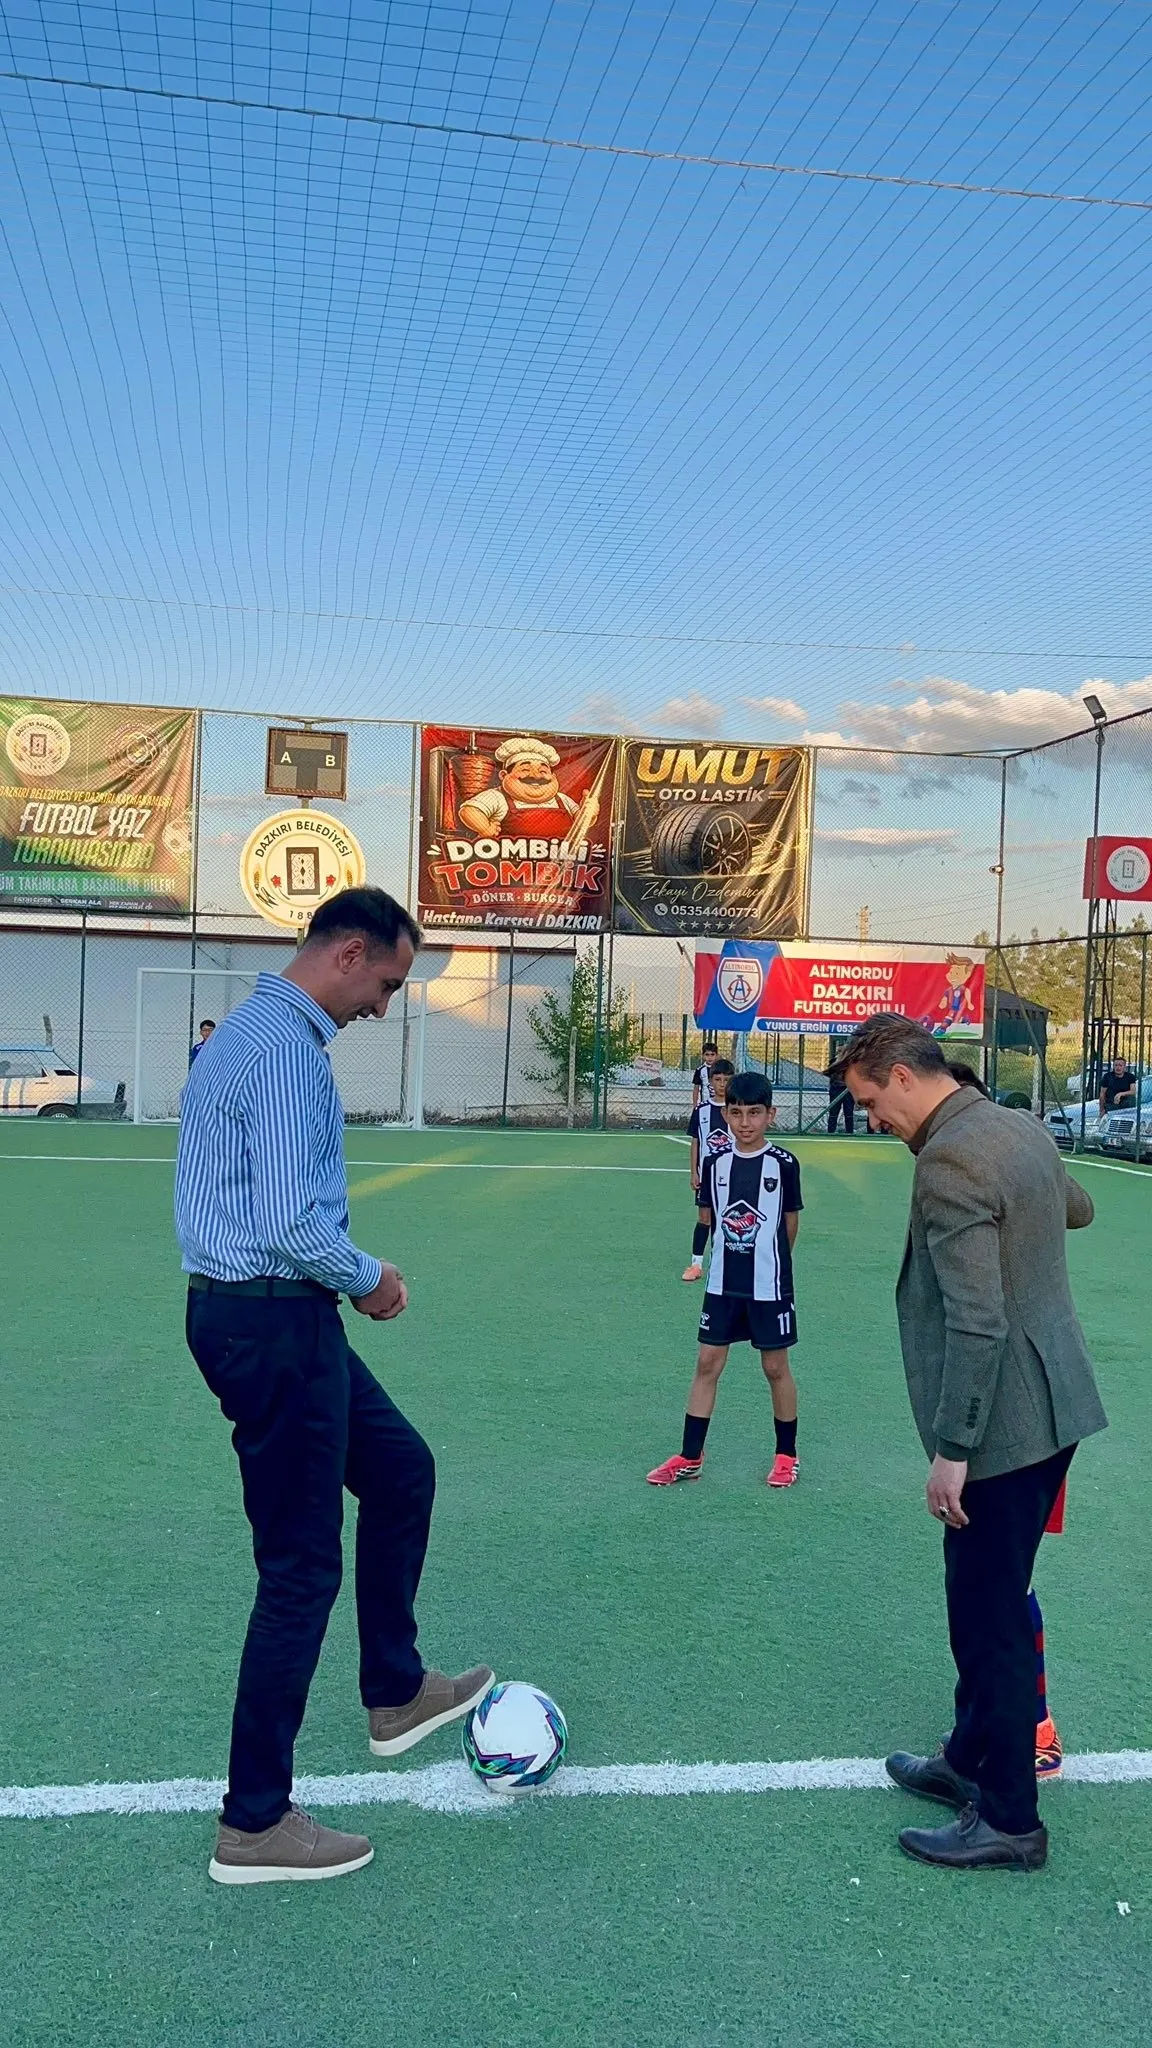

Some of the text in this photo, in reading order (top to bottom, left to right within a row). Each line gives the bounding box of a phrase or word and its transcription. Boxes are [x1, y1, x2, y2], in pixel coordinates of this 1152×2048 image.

[280, 752, 336, 767] A B
[637, 748, 793, 785] UMUT
[659, 786, 765, 802] OTO LASTİK
[19, 802, 151, 838] FUTBOL YAZ
[255, 820, 353, 858] DAZKIRI BELEDİYESİ
[0, 873, 14, 890] ÜM
[472, 890, 574, 906] DÖNER BURGER
[640, 879, 688, 904] Zekayi
[290, 910, 314, 920] 188
[423, 910, 482, 924] Hastane
[545, 914, 602, 930] DAZKIRI
[671, 905, 759, 918] 05354400773
[809, 964, 893, 981] ALTINORDU
[812, 984, 893, 1001] DAZKIRI
[794, 1000, 852, 1015] FUTBOL
[765, 1021, 798, 1031] YUNUS
[800, 1022, 830, 1032] ERGİN
[777, 1311, 790, 1335] 11
